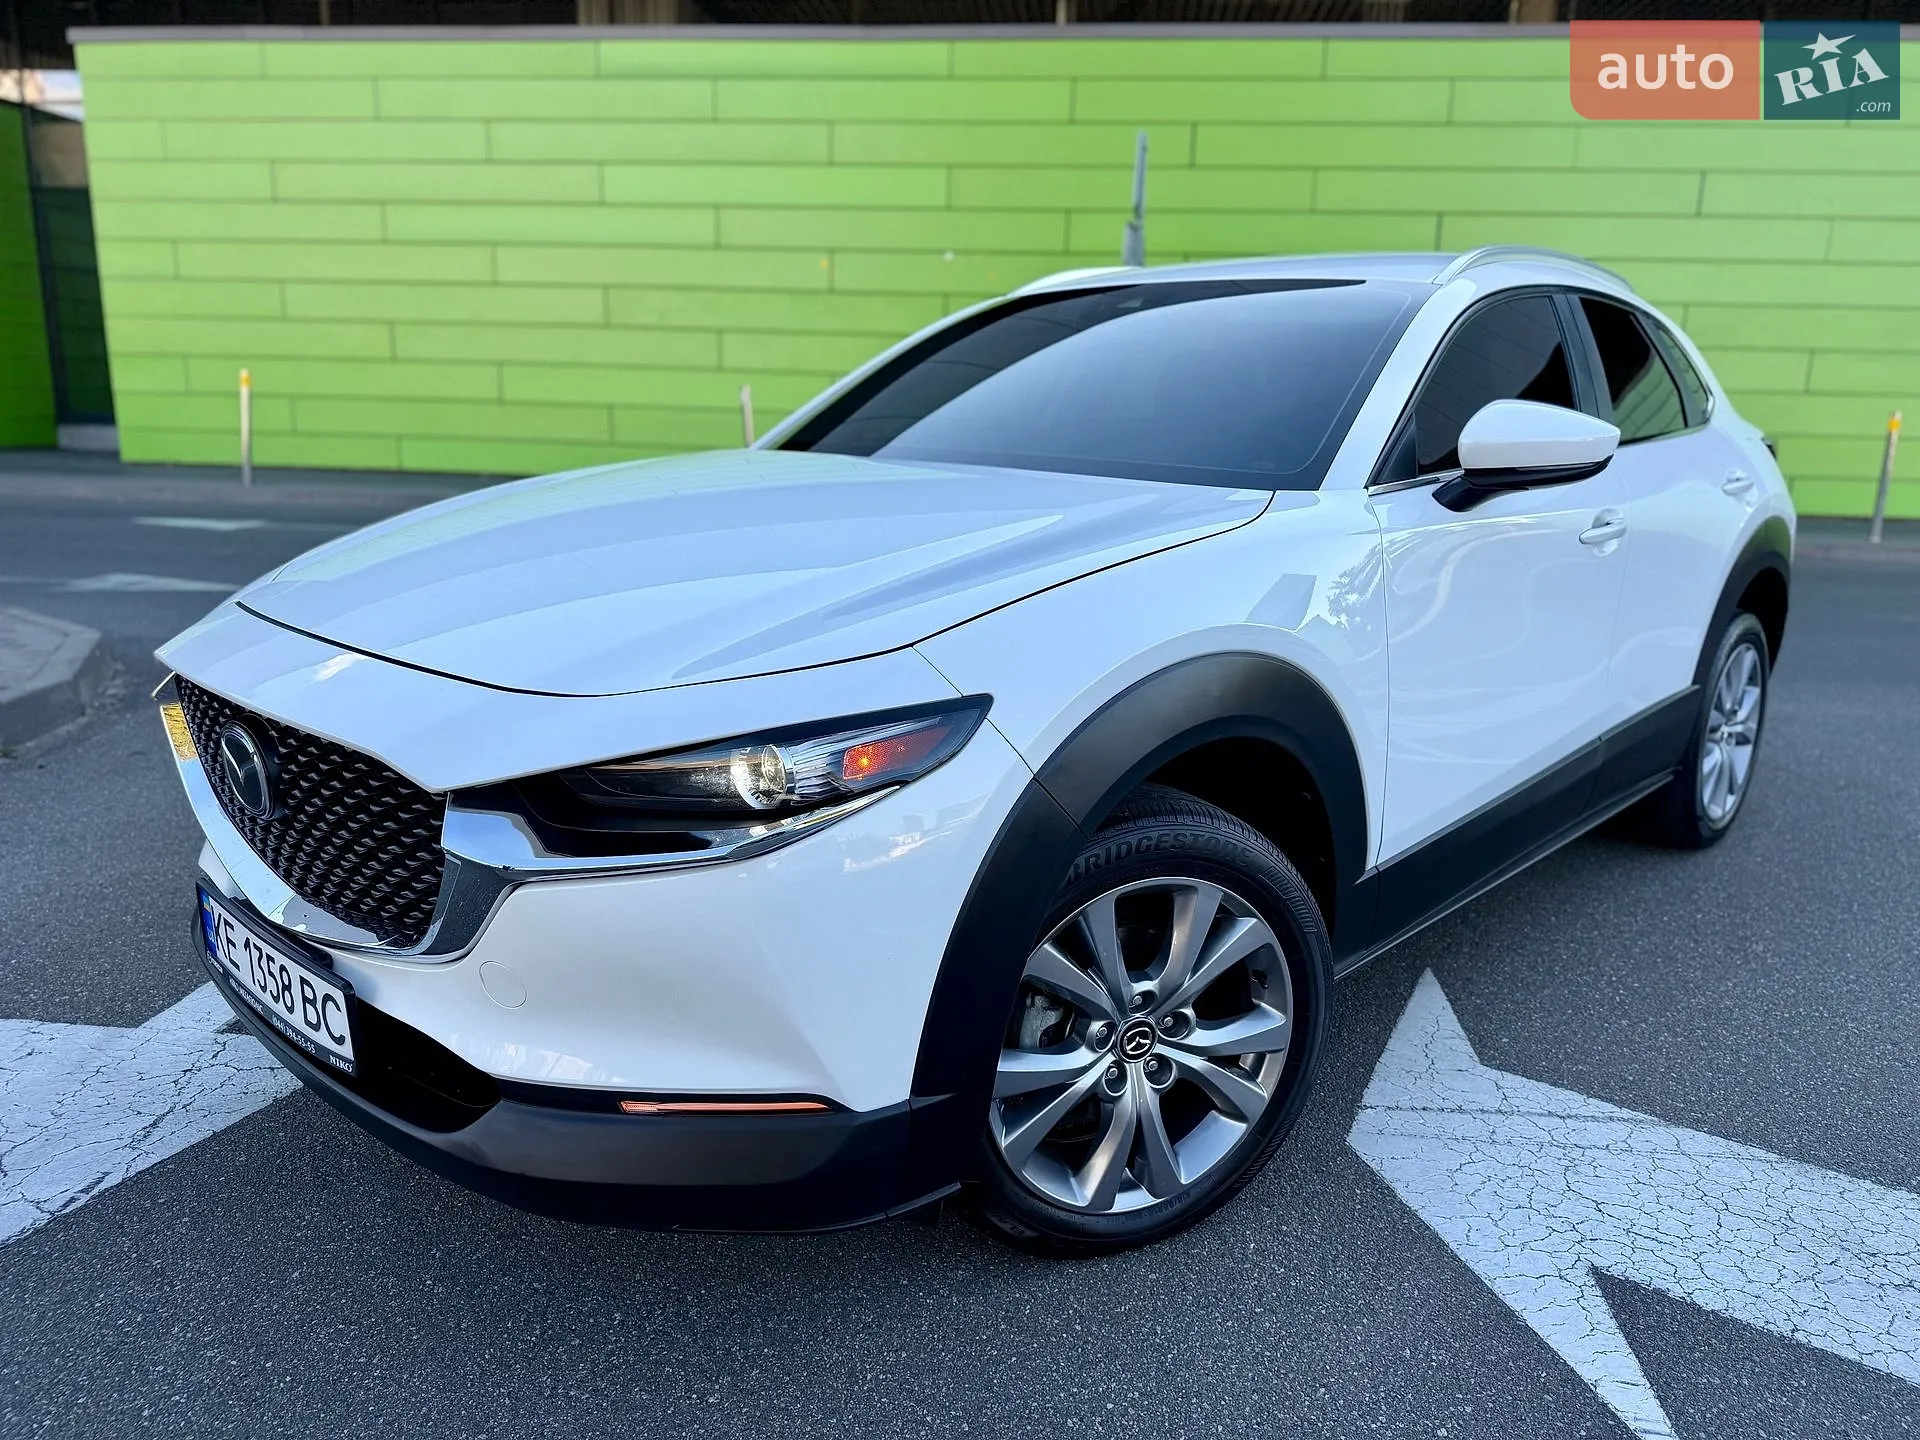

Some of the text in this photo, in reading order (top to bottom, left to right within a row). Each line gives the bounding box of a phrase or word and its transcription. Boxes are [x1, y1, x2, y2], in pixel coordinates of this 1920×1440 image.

[210, 902, 241, 973] KE
[243, 936, 295, 1015] 1358
[299, 974, 346, 1046] BC
[328, 1053, 353, 1073] NIKO
